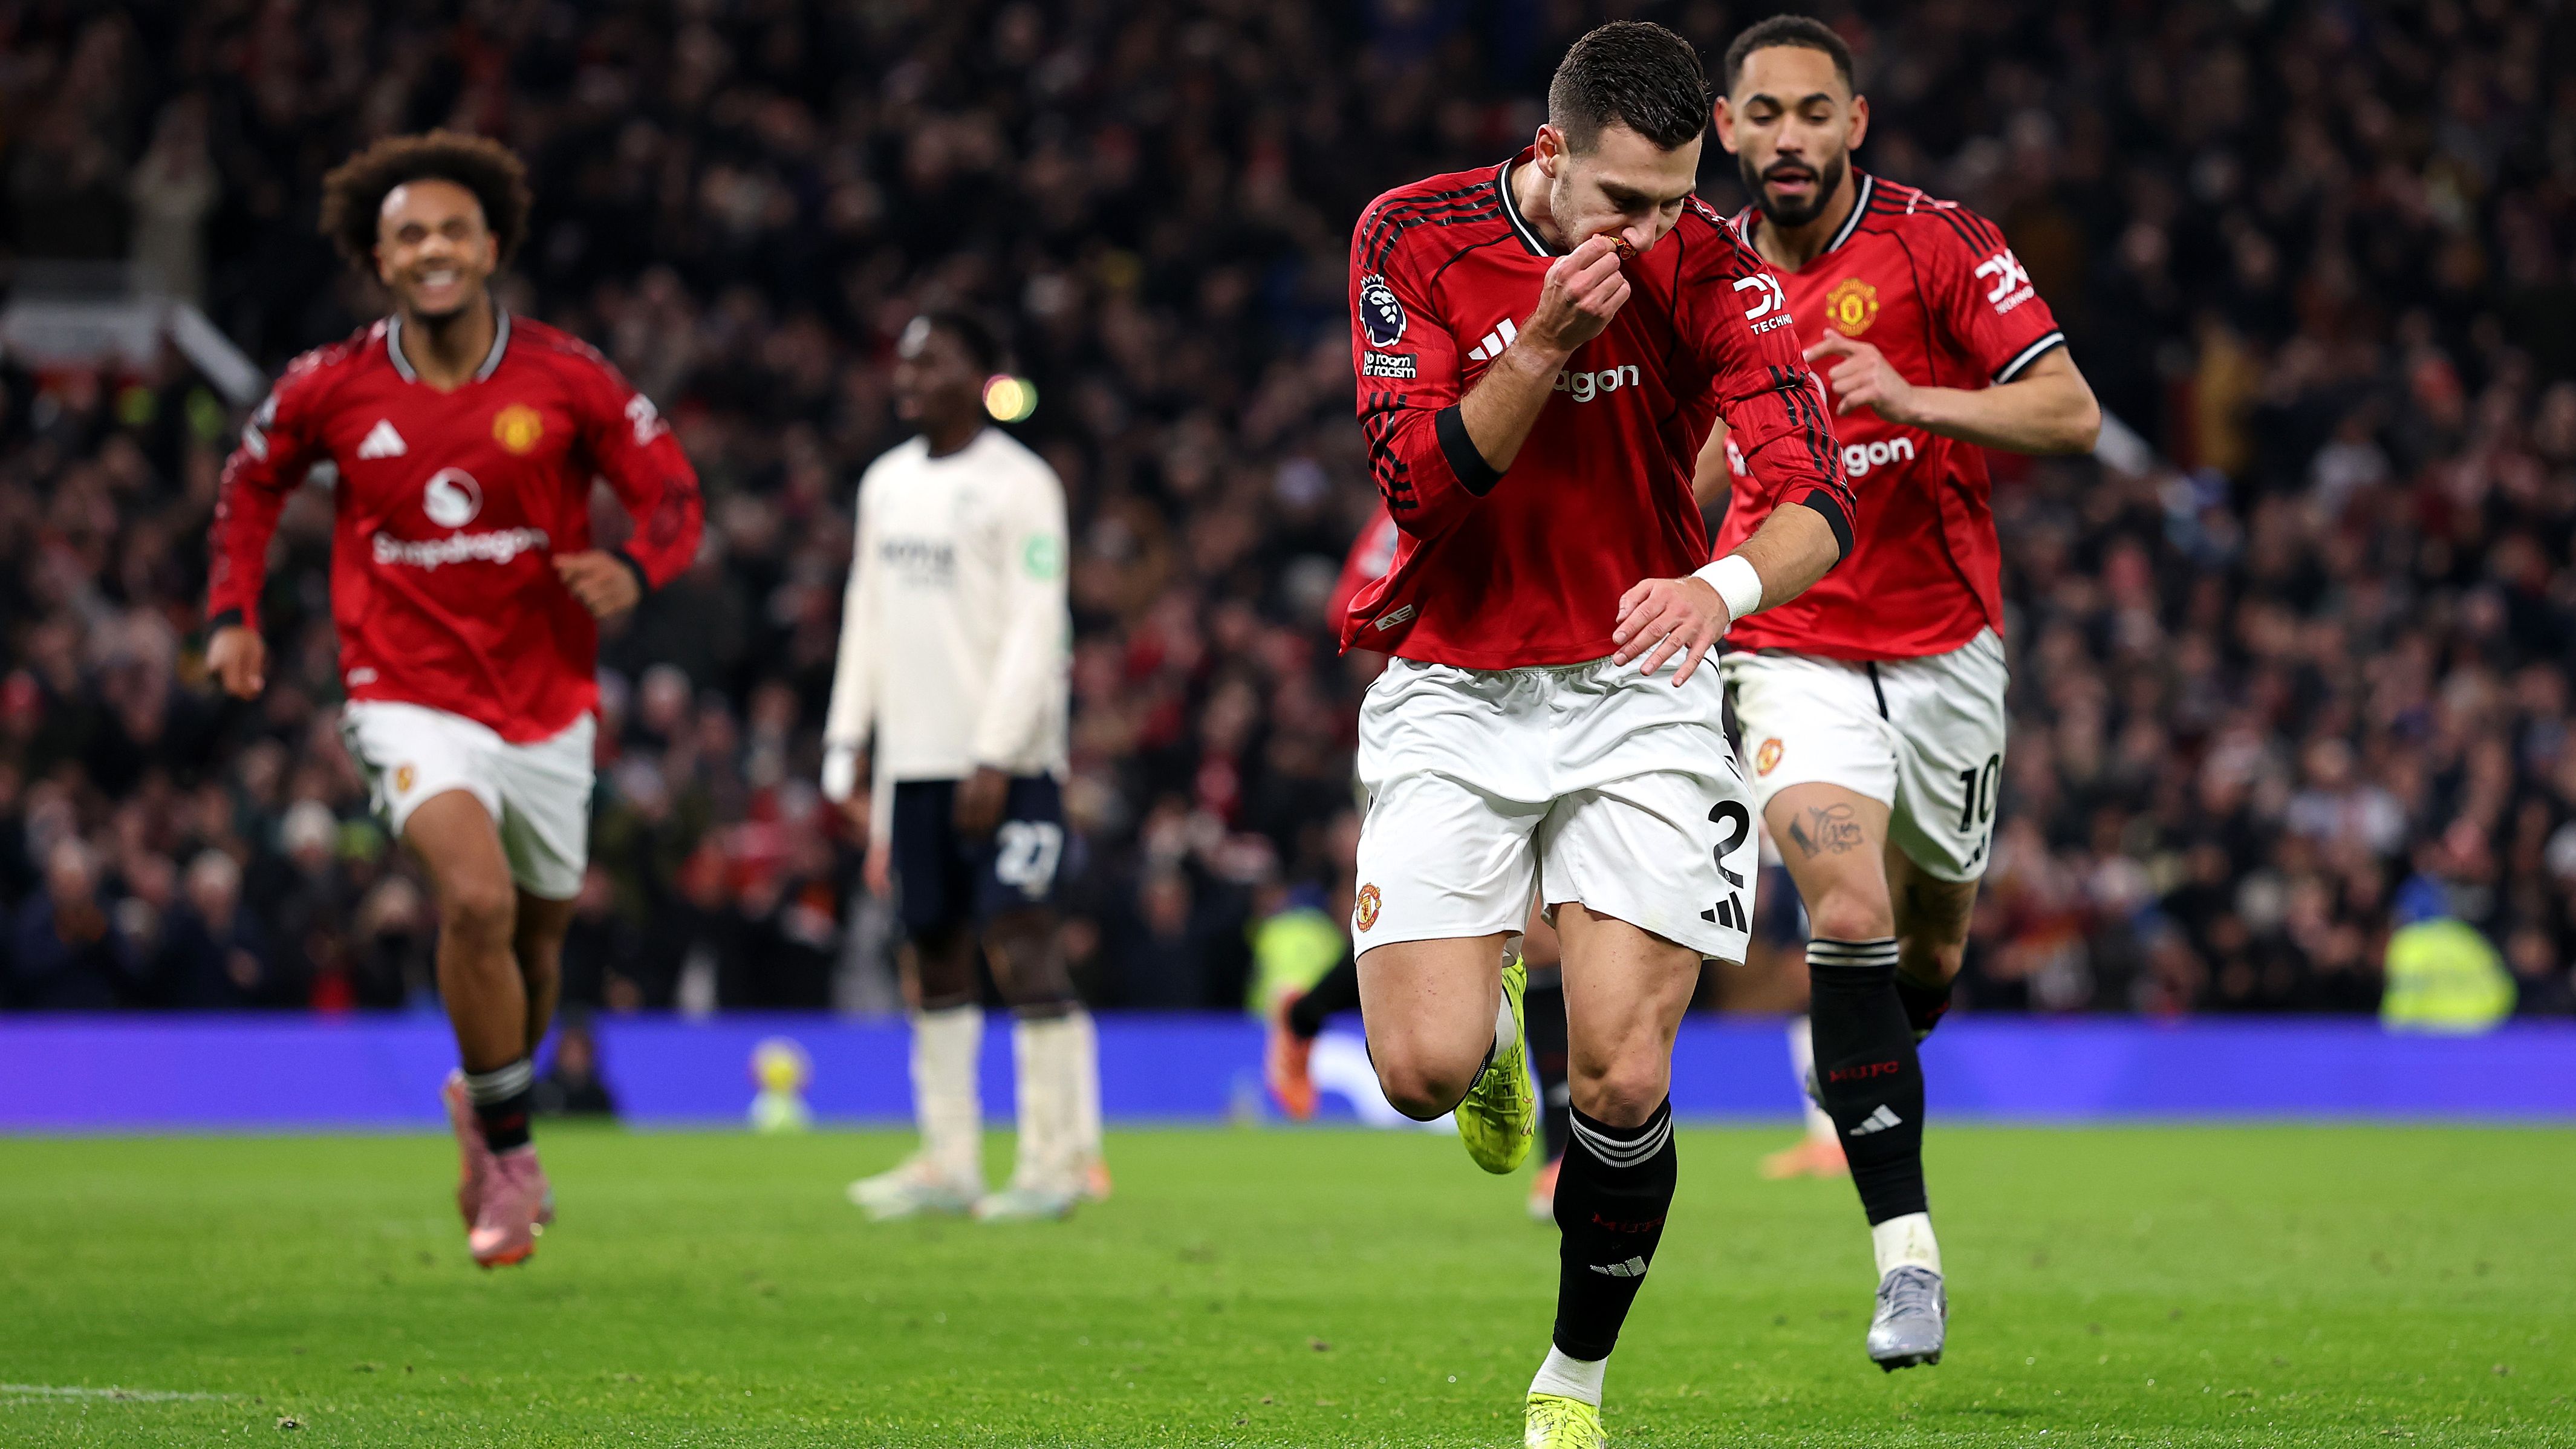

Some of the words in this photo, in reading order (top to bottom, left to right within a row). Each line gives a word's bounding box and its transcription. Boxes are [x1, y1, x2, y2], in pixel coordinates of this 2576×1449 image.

[1750, 313, 1793, 335] TECHNO
[1364, 351, 1374, 364] No
[1376, 354, 1411, 367] room
[1373, 365, 1416, 379] racism
[1843, 437, 1916, 477] gon
[372, 526, 550, 573] Snapdragon
[1959, 754, 2000, 833] 10
[995, 819, 1064, 895] 27
[1708, 799, 1750, 889] 2
[1829, 1061, 1900, 1083] MUFC
